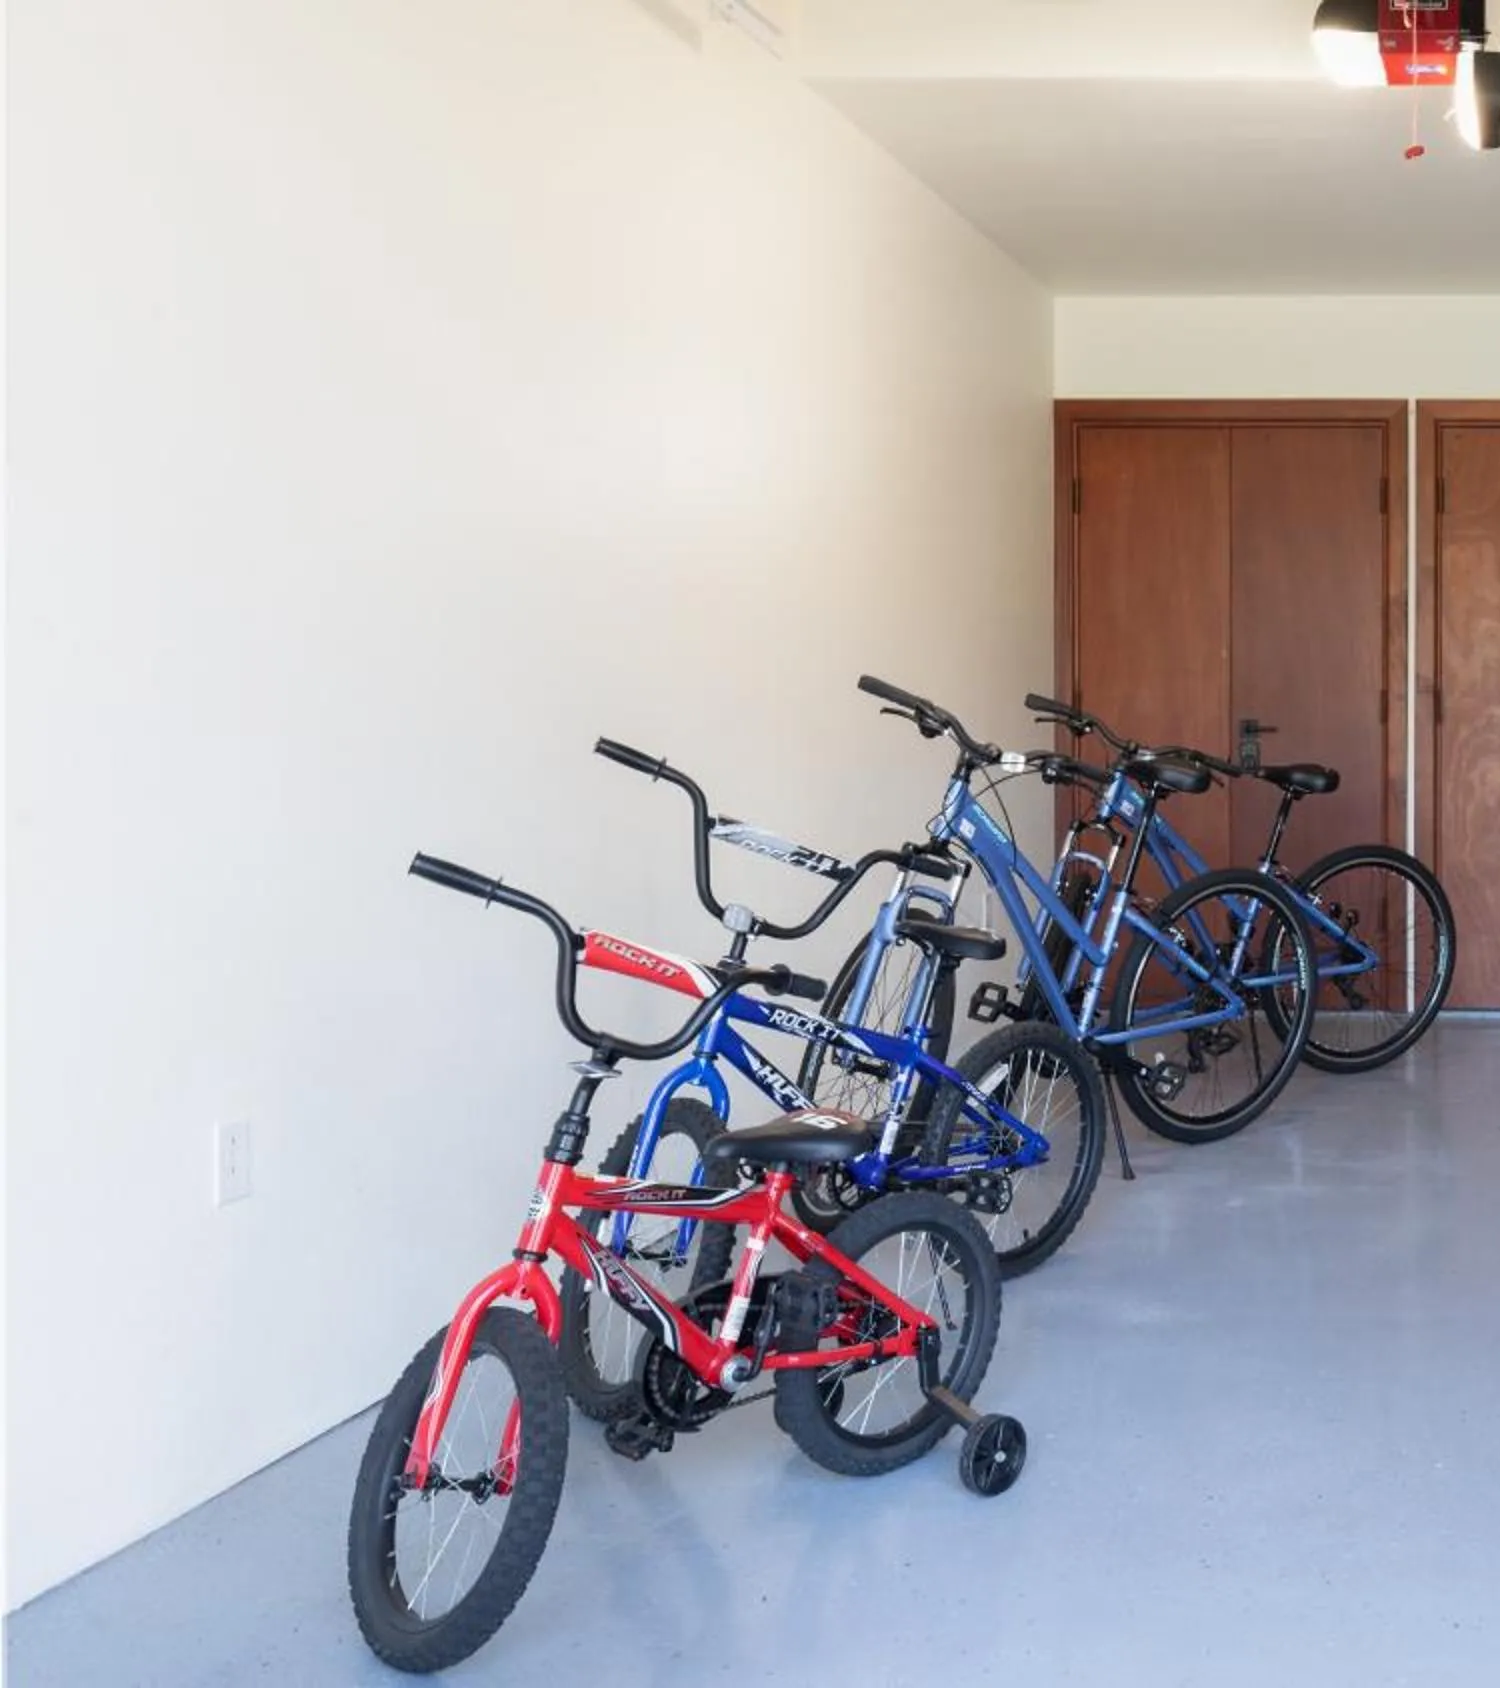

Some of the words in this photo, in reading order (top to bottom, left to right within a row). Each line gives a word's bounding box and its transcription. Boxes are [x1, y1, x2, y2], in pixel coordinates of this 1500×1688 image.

[593, 936, 657, 970] ROCK
[768, 1007, 819, 1033] ROCK
[817, 1022, 841, 1041] IT
[756, 1065, 818, 1109] HUFF
